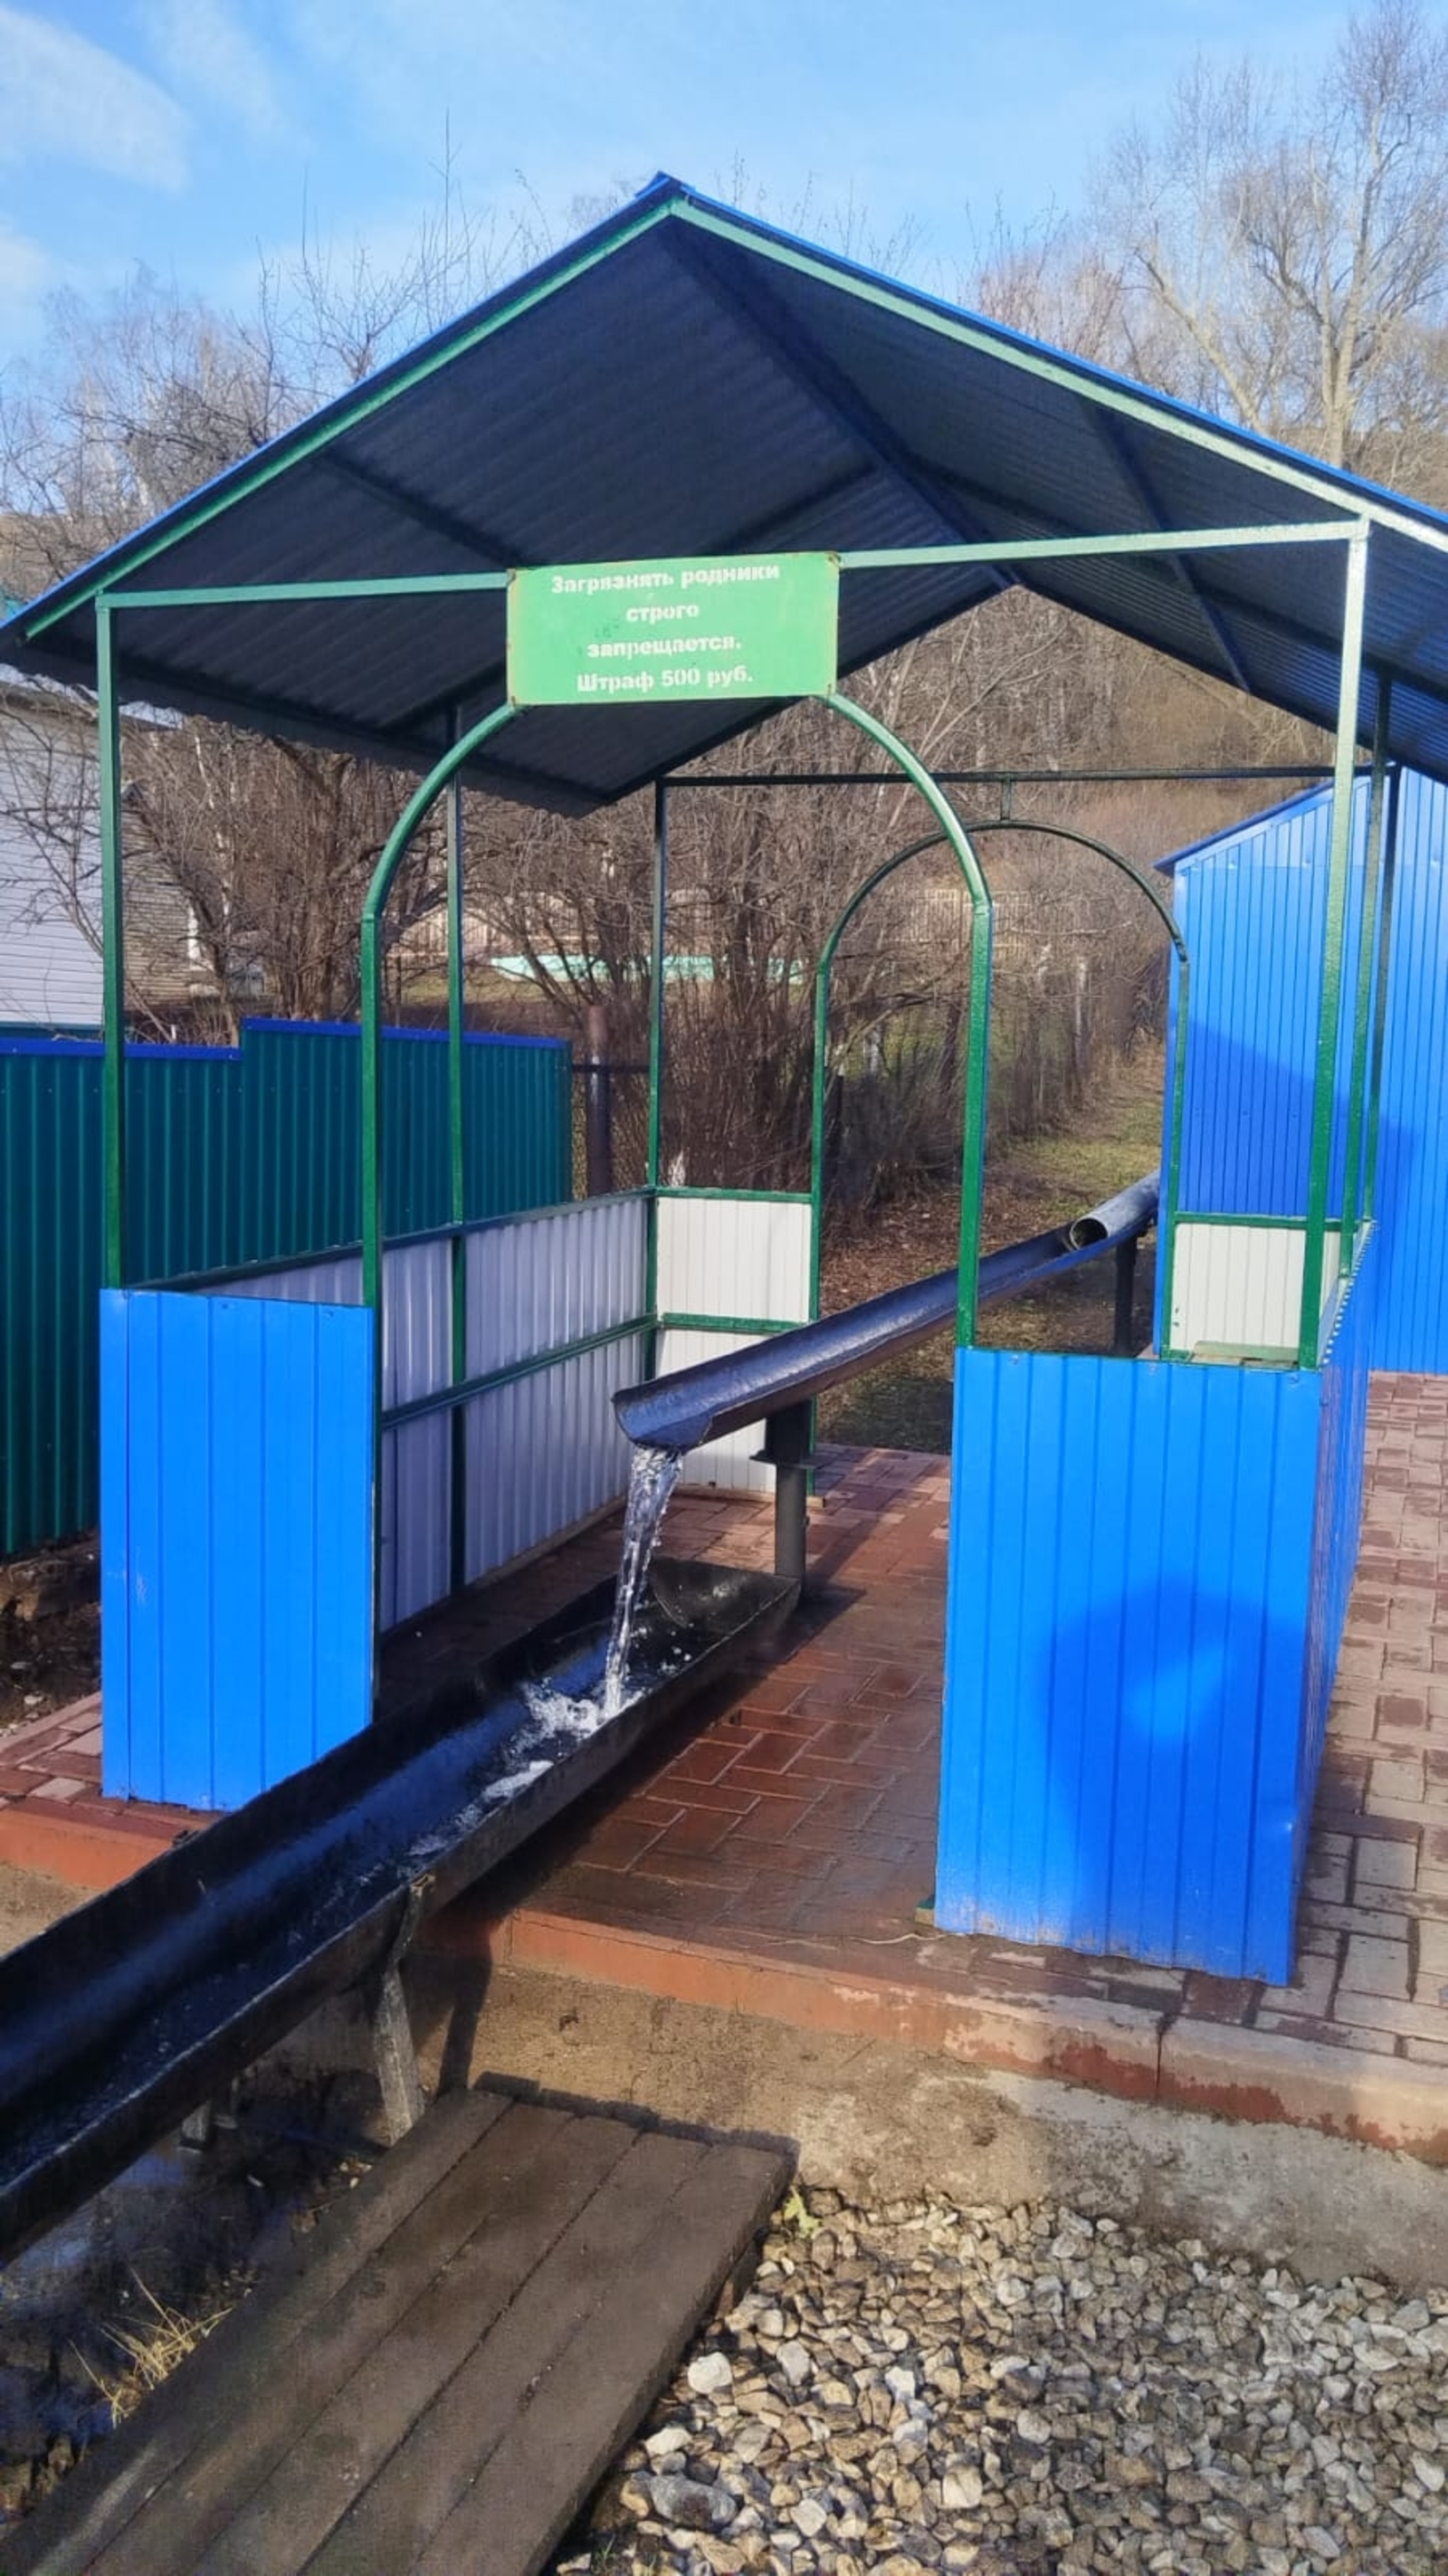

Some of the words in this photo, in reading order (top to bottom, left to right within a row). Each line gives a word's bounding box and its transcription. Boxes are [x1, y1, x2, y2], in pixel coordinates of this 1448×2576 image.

[551, 573, 674, 596] Загрязнять
[681, 565, 780, 590] родники
[625, 604, 700, 625] строго
[586, 634, 742, 661] запрещается.
[576, 672, 654, 694] Штраф
[661, 668, 700, 687] 500
[707, 665, 754, 689] руб.
